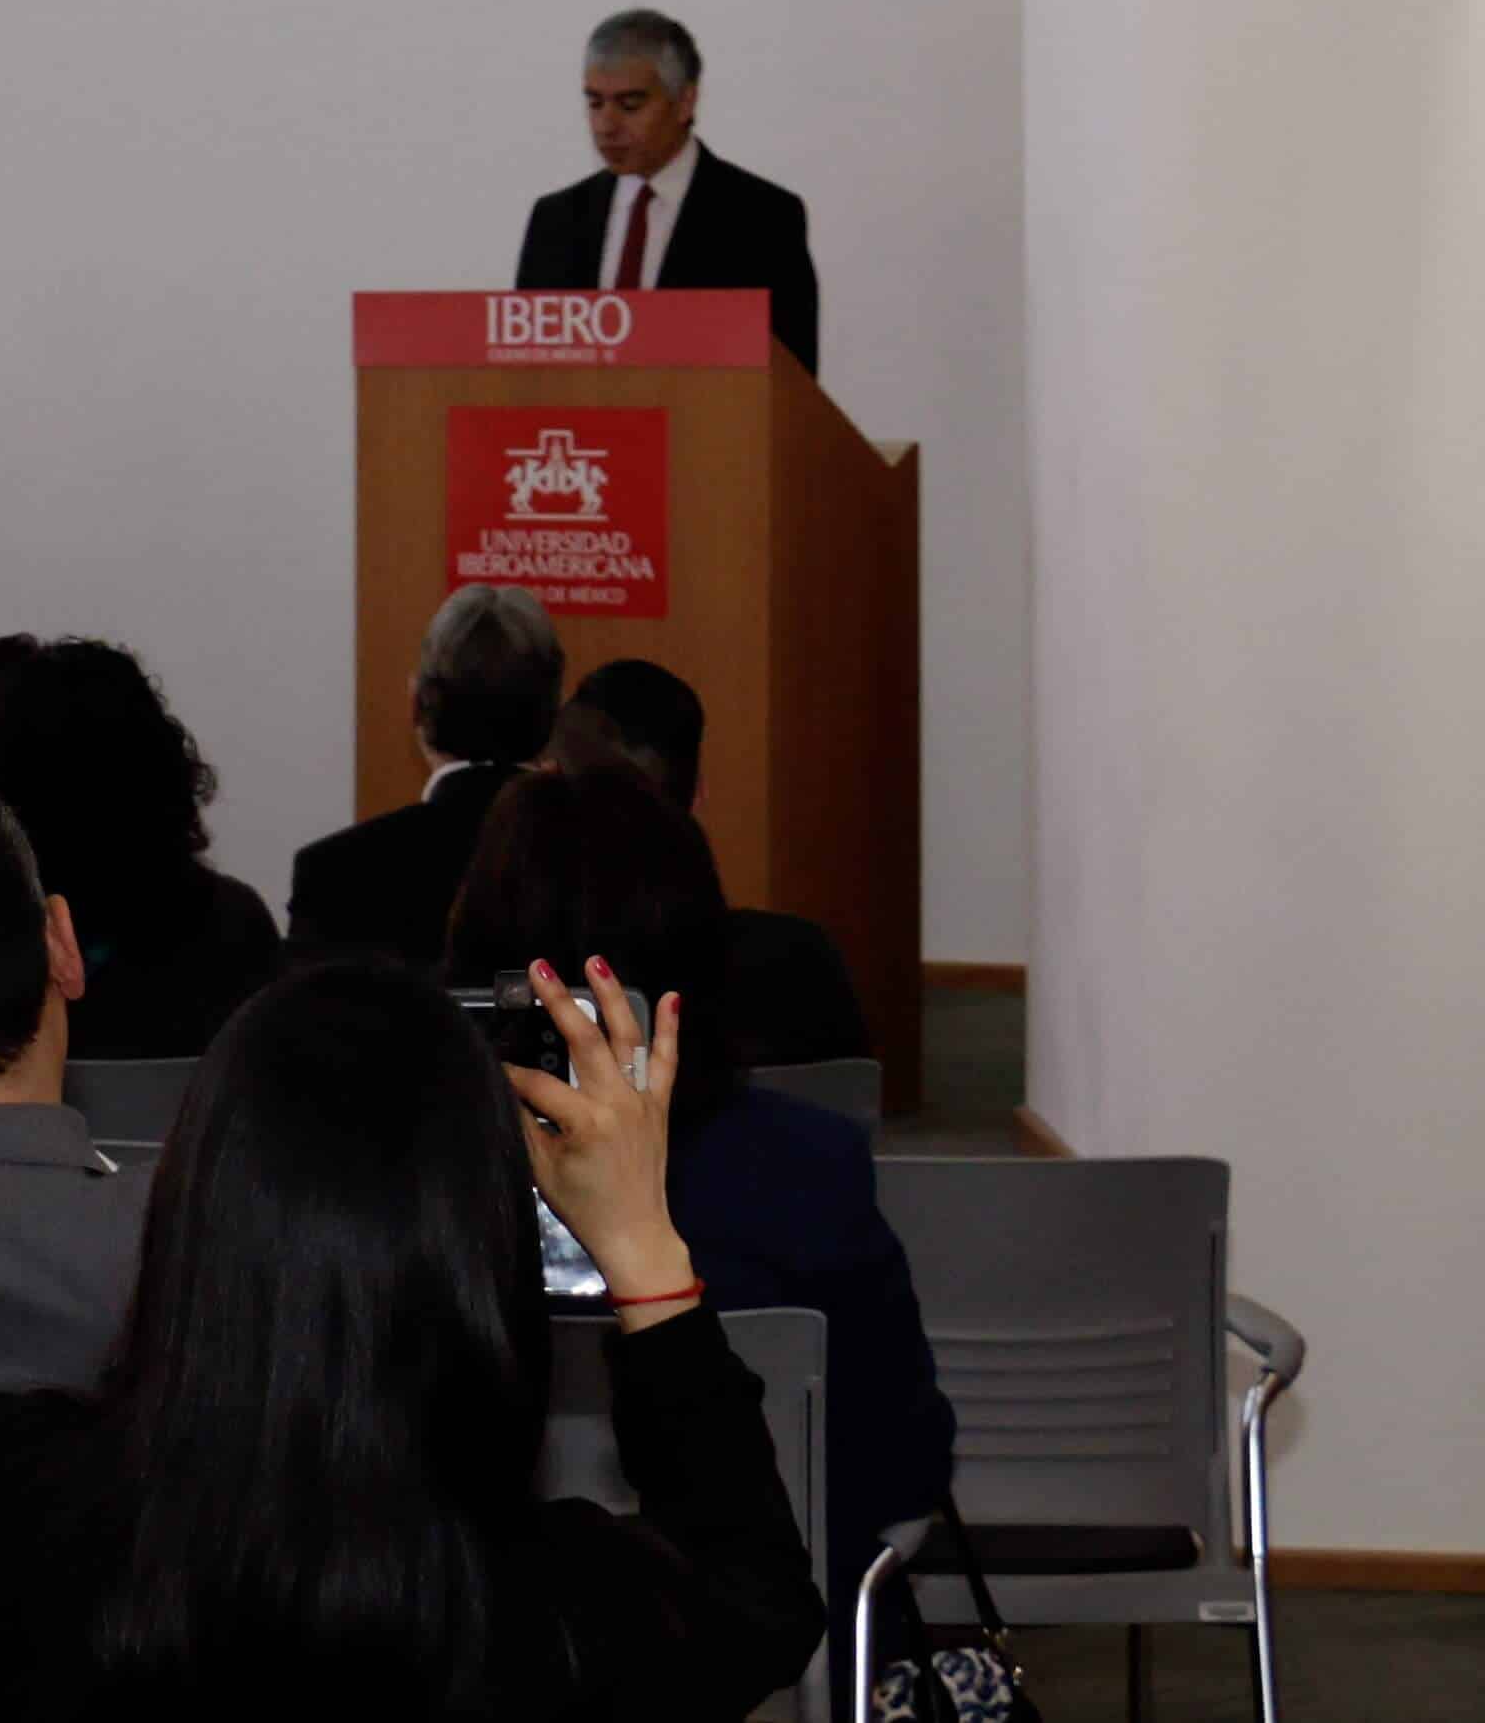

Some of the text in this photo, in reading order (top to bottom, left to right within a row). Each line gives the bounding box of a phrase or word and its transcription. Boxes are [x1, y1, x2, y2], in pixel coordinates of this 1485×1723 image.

[484, 293, 633, 346] IBERO
[479, 528, 633, 555] UNIVERSIDAD
[456, 551, 656, 582] IBEROAMERICANA
